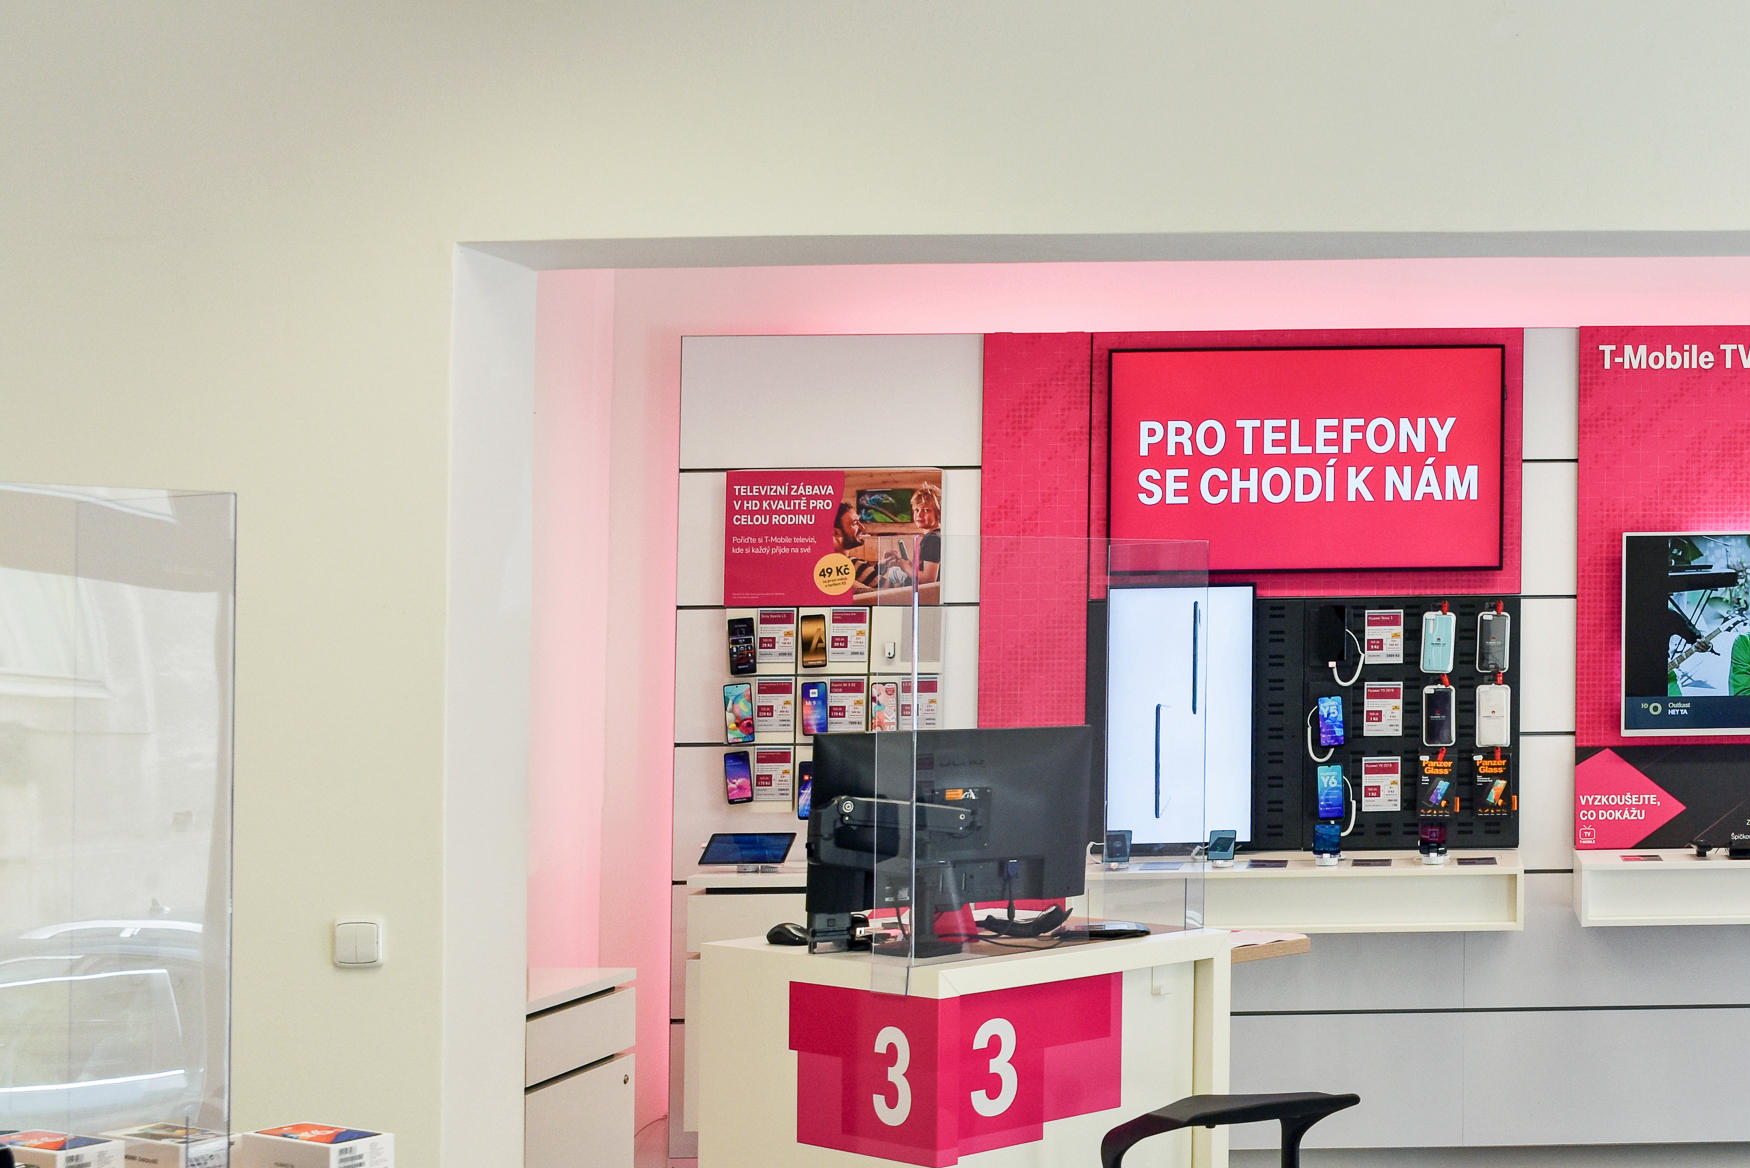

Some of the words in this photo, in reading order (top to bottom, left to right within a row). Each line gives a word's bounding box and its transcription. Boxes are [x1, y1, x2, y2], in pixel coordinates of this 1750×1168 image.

[1598, 344, 1715, 370] T-Mobile
[1139, 419, 1226, 457] PRO
[1235, 417, 1457, 455] TELEFONY
[1137, 468, 1189, 505] SE
[1200, 458, 1339, 504] CHODÍ
[1347, 466, 1375, 501] K
[1385, 457, 1479, 501] NÁM
[733, 483, 789, 496] TELEVIZNÍ
[790, 482, 835, 496] ZÁBAVA
[733, 501, 742, 511] V
[743, 501, 760, 511] HD
[762, 498, 808, 511] KVALITĚ
[809, 500, 833, 510] PRO
[733, 515, 770, 525] CELOU
[772, 515, 816, 525] RODINU
[757, 536, 763, 544] si
[764, 536, 793, 544] T-Mobile
[751, 546, 770, 555] každý
[819, 567, 834, 578] 49
[836, 564, 851, 577] Kč
[1321, 705, 1338, 718] Y5
[1320, 776, 1337, 787] Y6
[1579, 793, 1661, 806] VYZKOUŠEJTE,
[1579, 810, 1596, 820] CO
[1598, 807, 1645, 820] DOKÁŽU
[970, 1017, 1018, 1117] 3
[872, 1026, 912, 1127] 3
